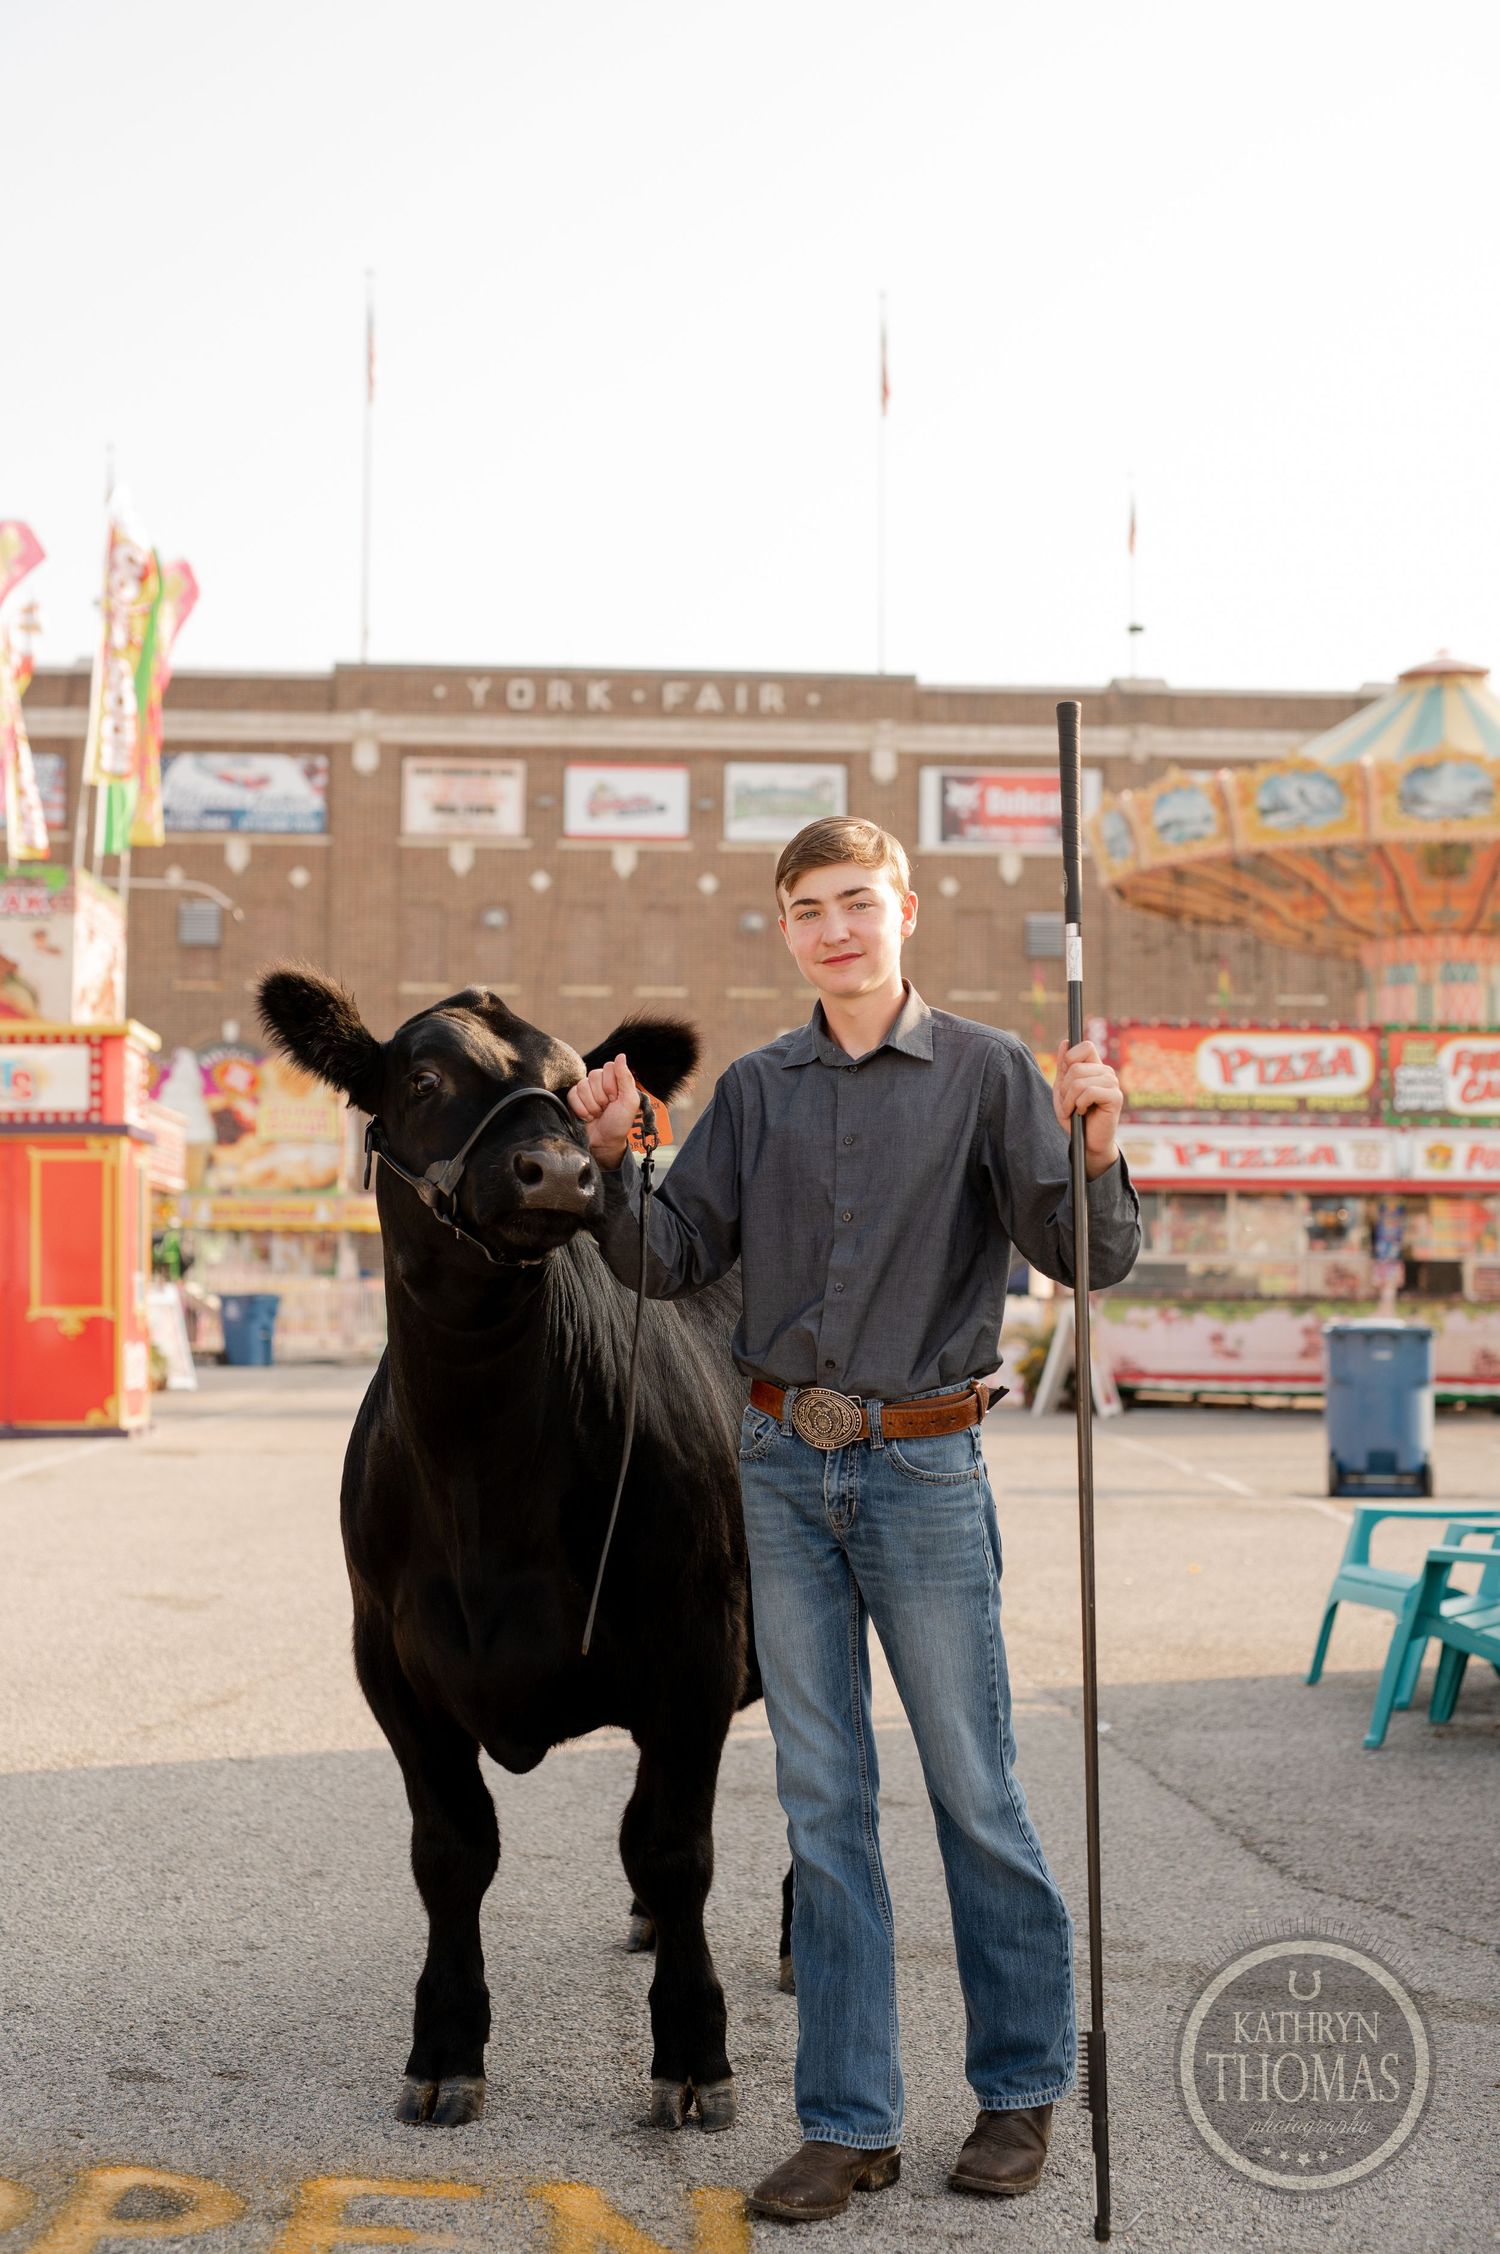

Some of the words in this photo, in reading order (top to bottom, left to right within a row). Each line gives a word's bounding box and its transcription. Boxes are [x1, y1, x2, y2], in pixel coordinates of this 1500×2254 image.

[467, 677, 612, 713] YORK
[661, 680, 787, 714] FAIR
[985, 785, 1061, 816] Bobca
[1211, 1045, 1357, 1086] PIZZA
[1165, 1139, 1339, 1168] PIZZA
